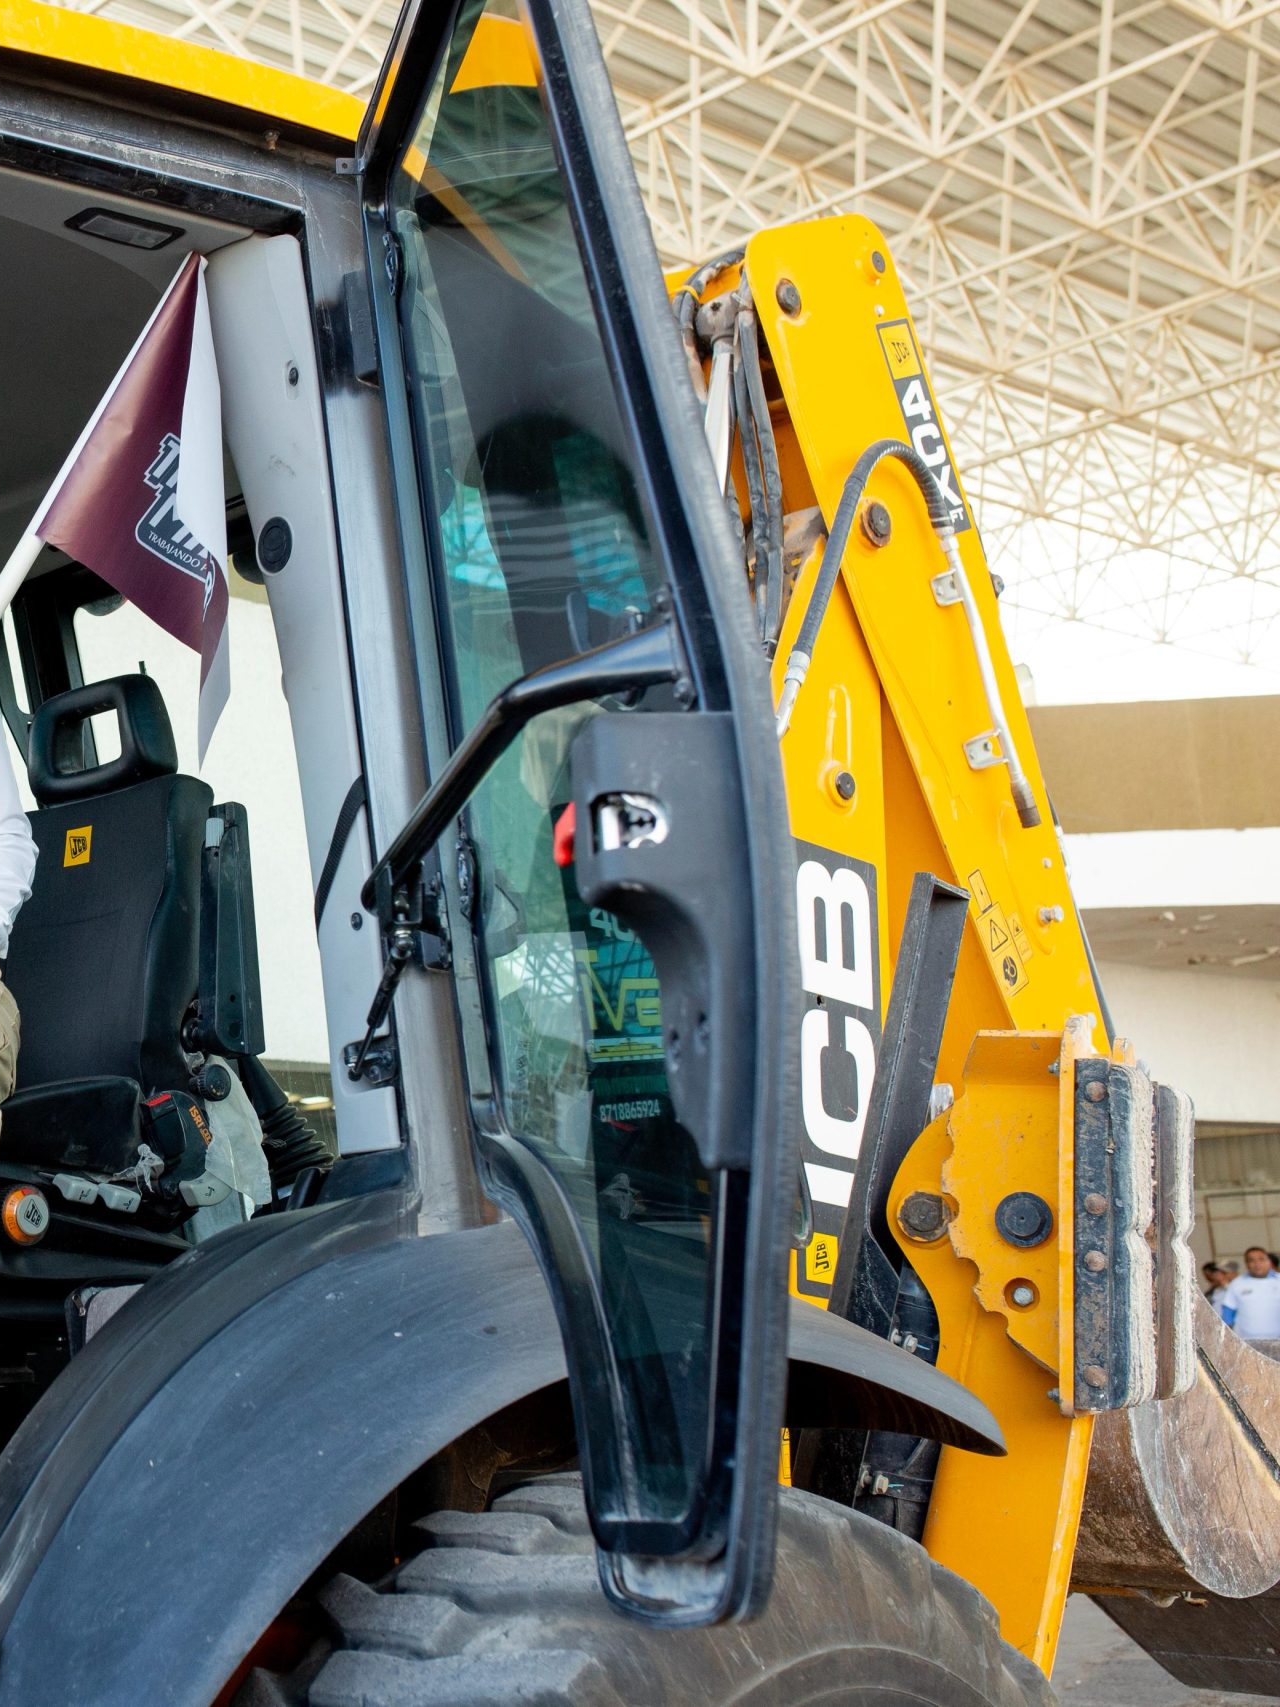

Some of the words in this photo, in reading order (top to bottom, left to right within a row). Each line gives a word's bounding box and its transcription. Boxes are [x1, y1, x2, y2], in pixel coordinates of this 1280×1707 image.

[148, 530, 201, 571] TRABAJANDO
[72, 838, 87, 856] JCB
[26, 1203, 43, 1226] JCB
[816, 1243, 830, 1270] JCB
